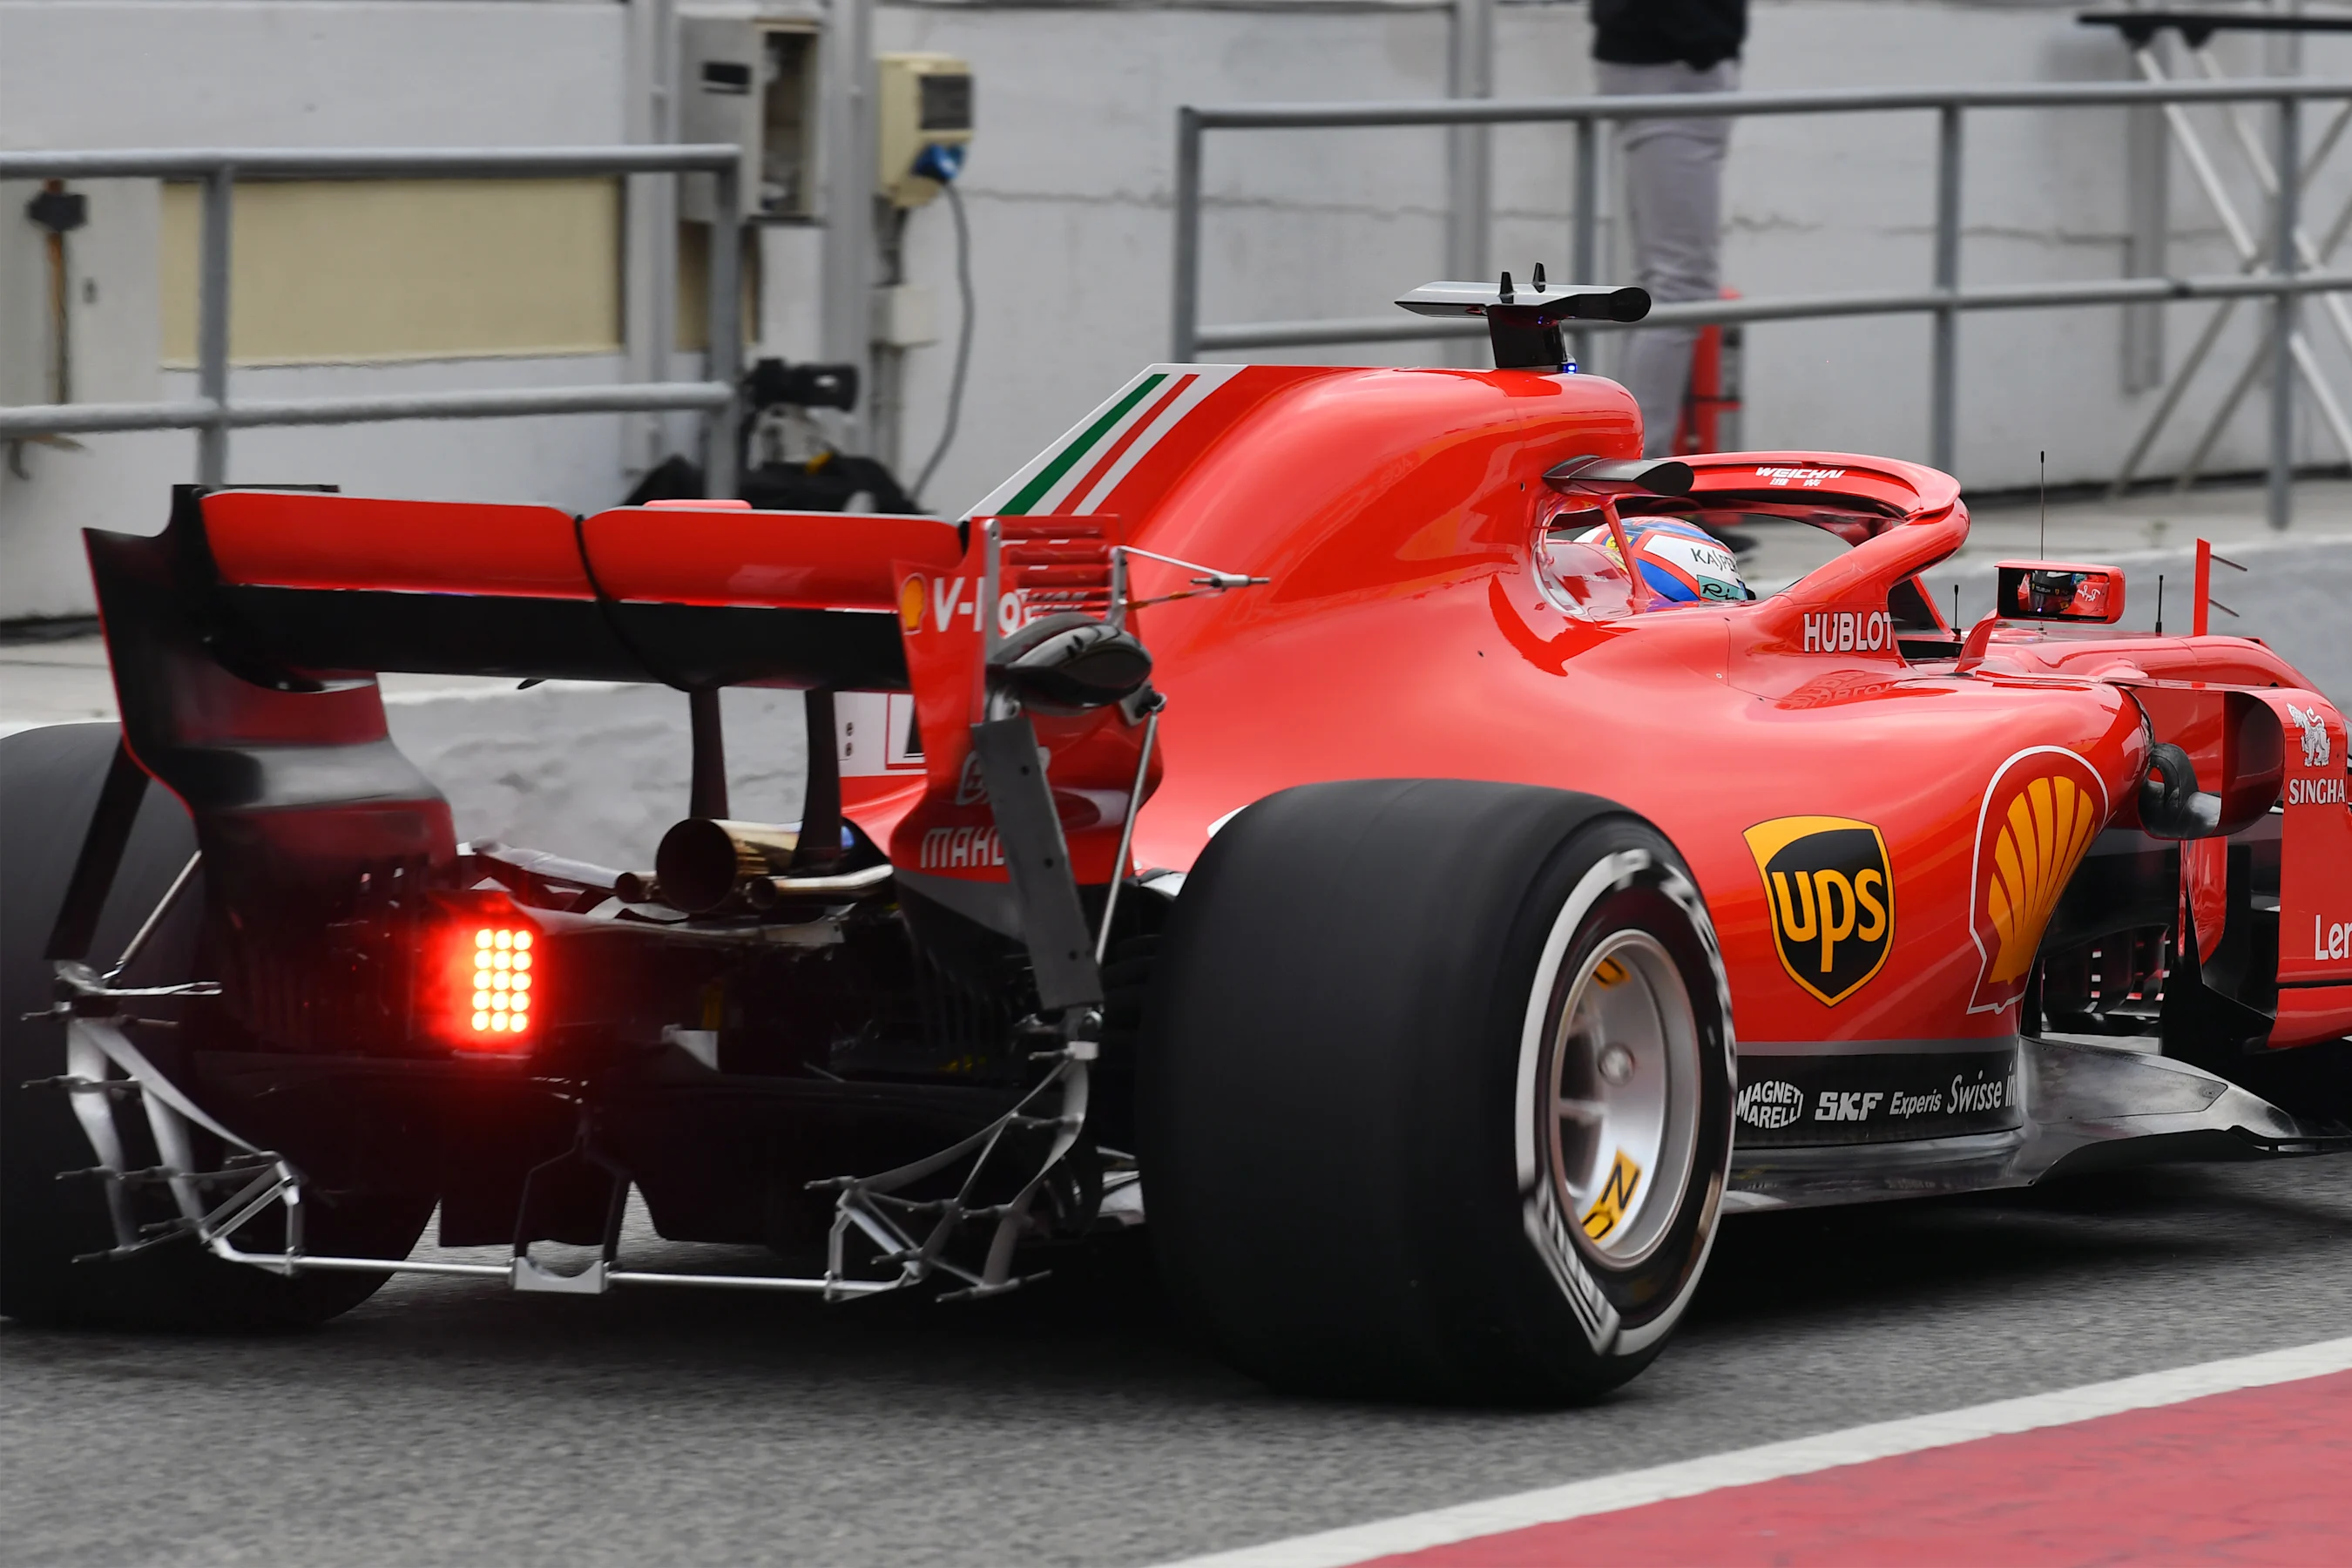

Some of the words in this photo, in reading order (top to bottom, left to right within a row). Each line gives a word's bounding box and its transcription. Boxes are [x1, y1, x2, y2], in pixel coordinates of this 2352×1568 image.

[1755, 466, 1847, 479] WEICHAI
[1803, 611, 1892, 652] HUBLOT
[2288, 778, 2346, 805] SINGHA
[921, 826, 1005, 868] MAHL
[1815, 1092, 1884, 1121] SKF
[1889, 1088, 1943, 1119] Experis
[1946, 1070, 2003, 1114] Swisse
